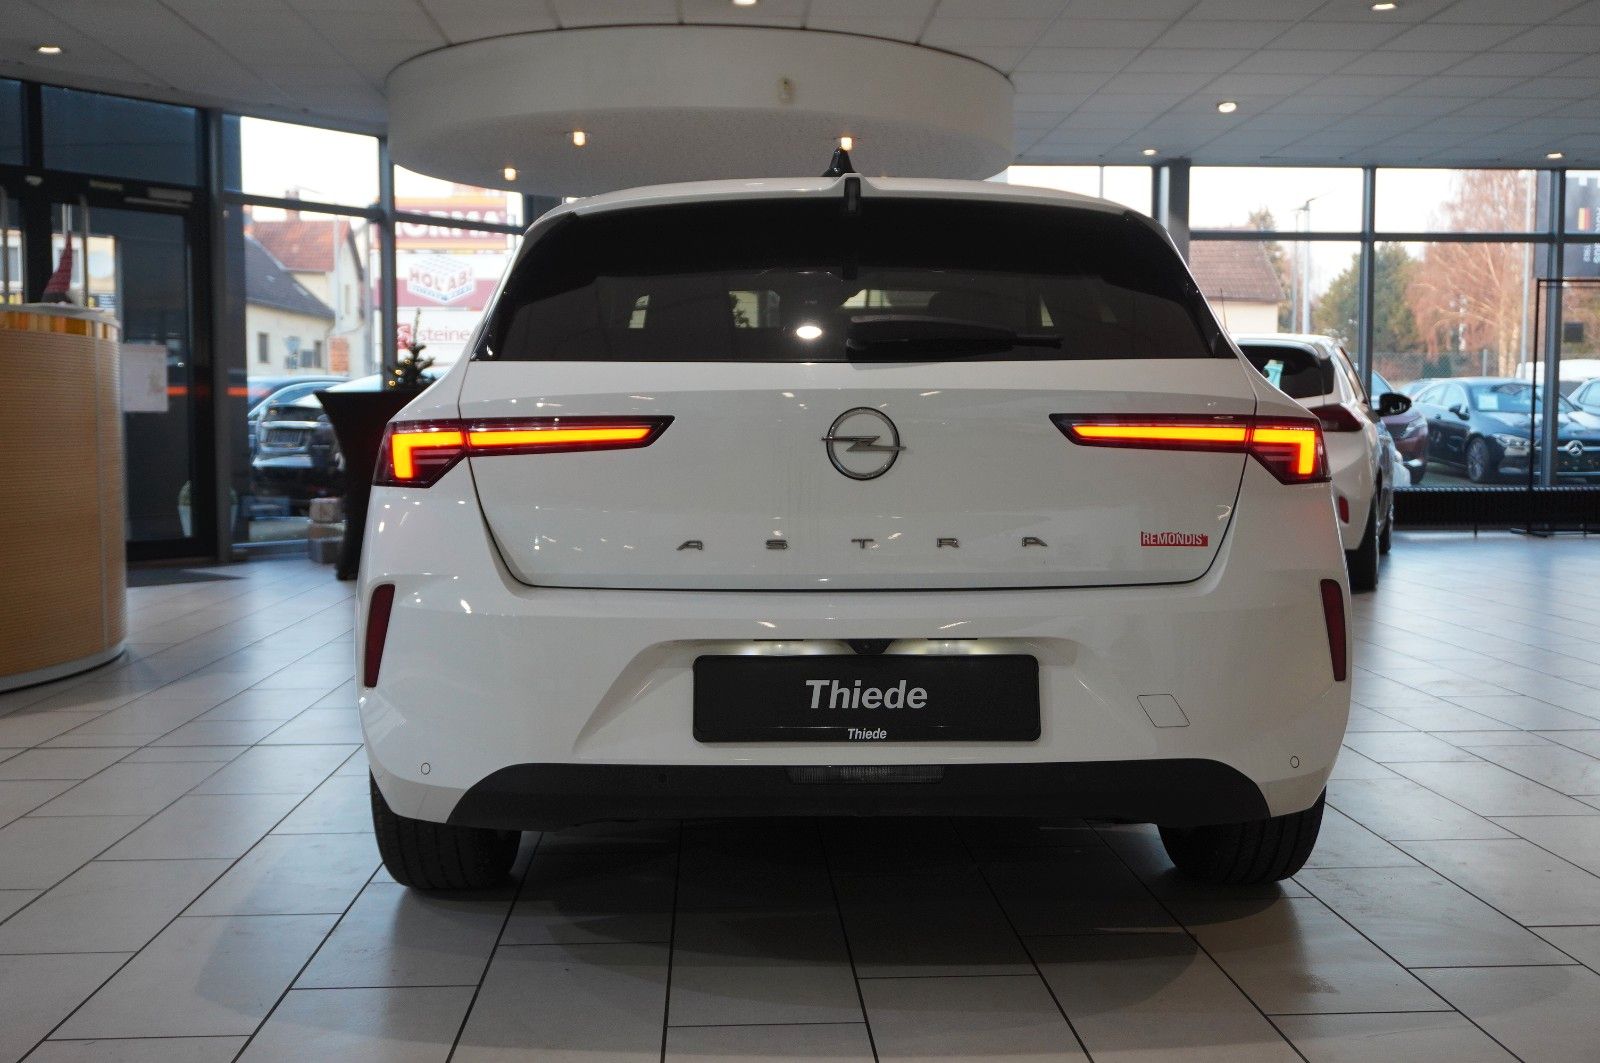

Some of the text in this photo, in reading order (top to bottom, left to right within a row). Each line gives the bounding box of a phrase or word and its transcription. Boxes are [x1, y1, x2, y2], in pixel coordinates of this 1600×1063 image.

[419, 326, 470, 341] steine
[676, 536, 1048, 551] ASTRA
[1142, 533, 1204, 545] REMONDIS
[806, 679, 928, 709] Thiede
[847, 728, 888, 740] Thiede
